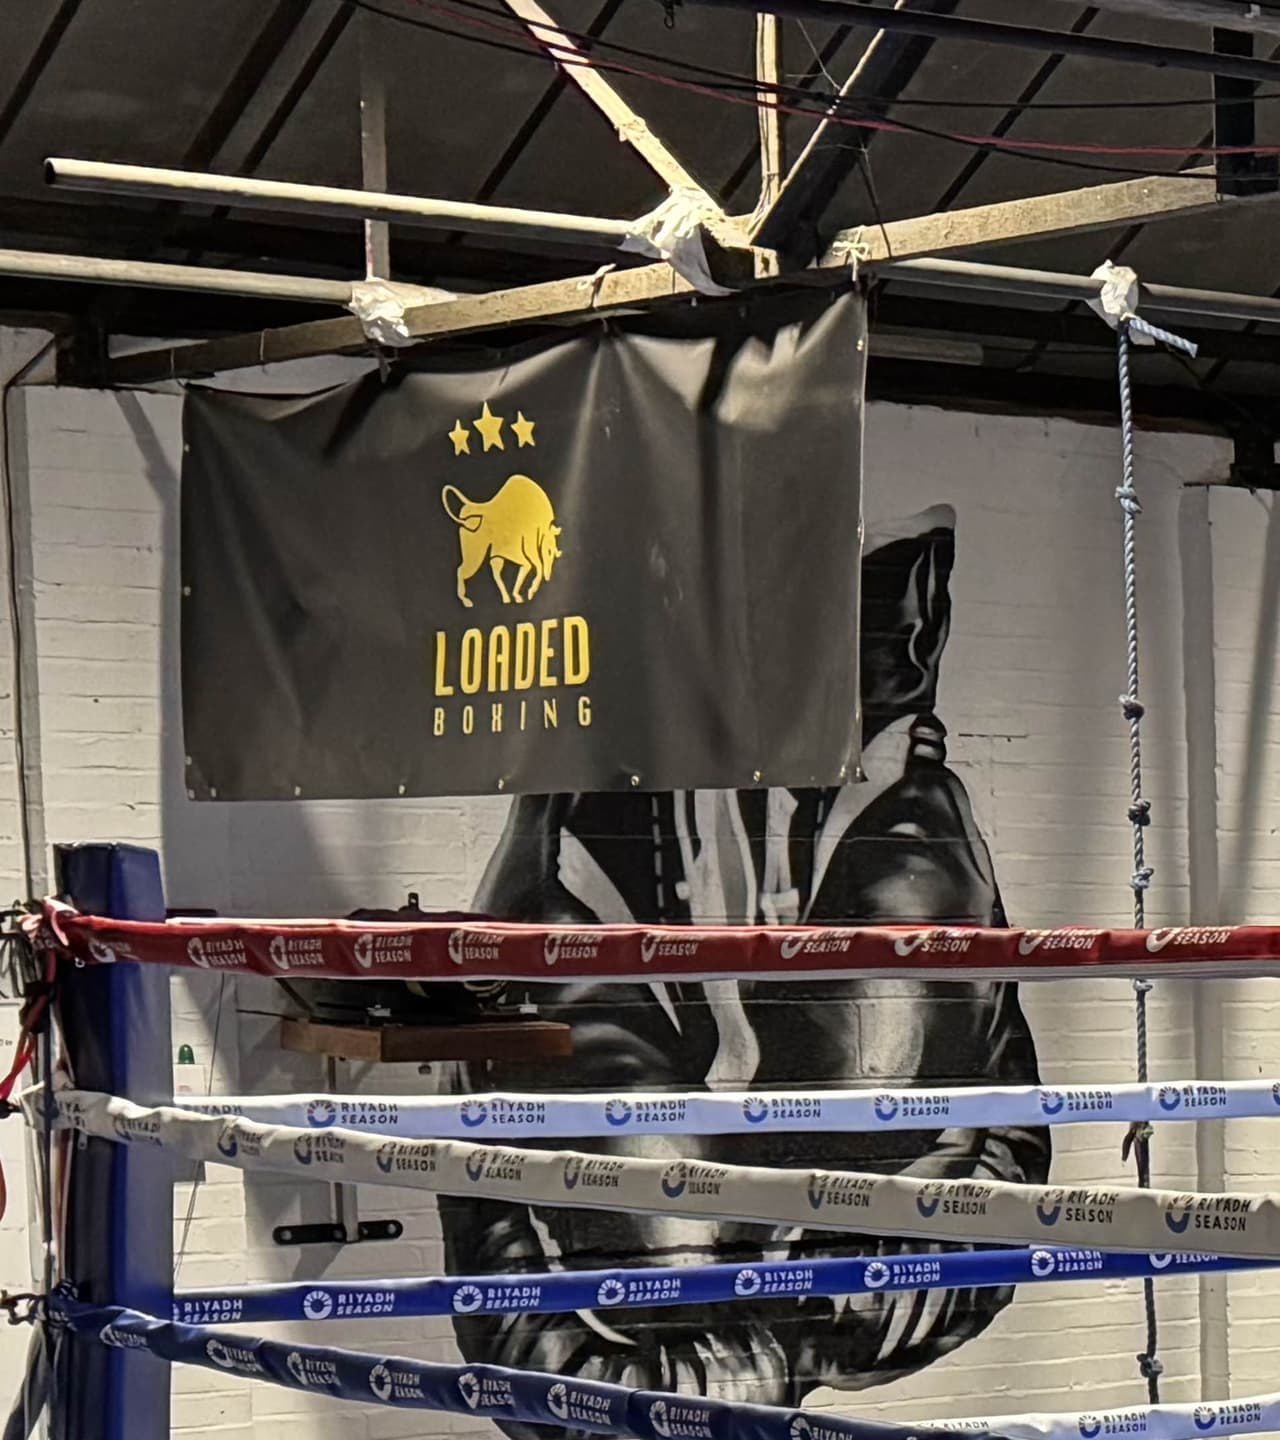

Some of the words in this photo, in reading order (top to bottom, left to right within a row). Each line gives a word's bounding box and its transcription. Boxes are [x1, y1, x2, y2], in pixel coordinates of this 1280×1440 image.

[434, 615, 590, 697] LOADED
[433, 695, 592, 736] BOXING
[341, 1102, 398, 1113] RIYADH
[492, 1102, 546, 1113] RIYADH
[636, 1101, 686, 1112] RIYADH
[341, 1113, 398, 1127] SEASON
[492, 1113, 546, 1126] SEASON
[636, 1111, 685, 1123] SEASON
[943, 1199, 987, 1215] SEASON
[1196, 1197, 1250, 1213] RIYADH
[1195, 1215, 1246, 1231] SEASON
[339, 1292, 395, 1304] RIYADH
[487, 1286, 541, 1298] RIYADH
[336, 1304, 392, 1315] SEASON
[487, 1298, 540, 1309] SEASON
